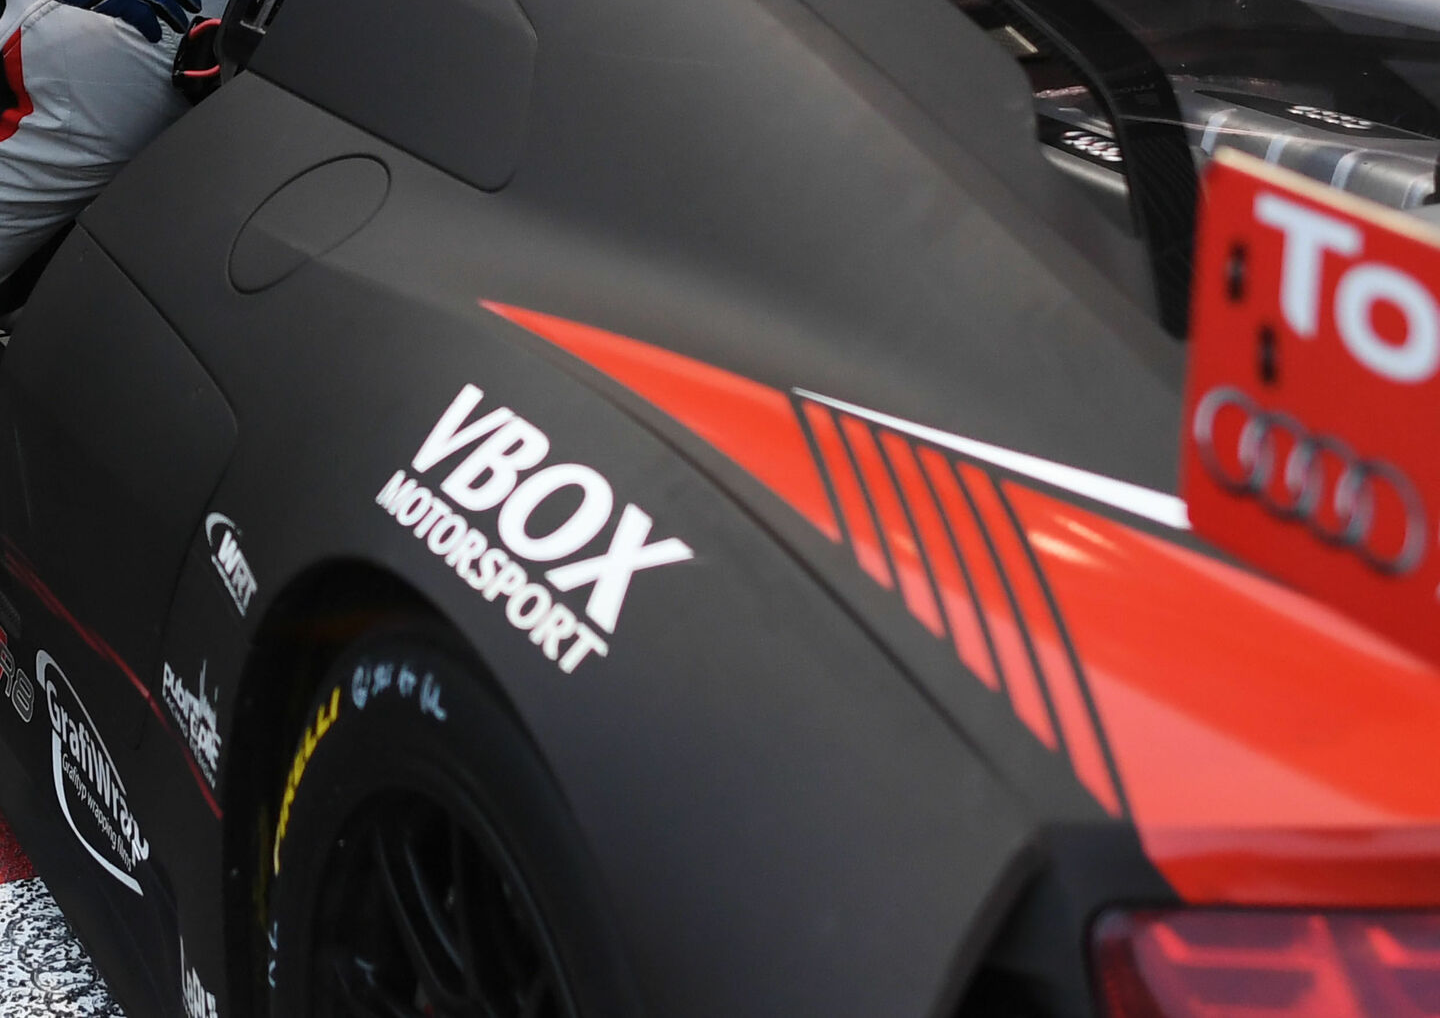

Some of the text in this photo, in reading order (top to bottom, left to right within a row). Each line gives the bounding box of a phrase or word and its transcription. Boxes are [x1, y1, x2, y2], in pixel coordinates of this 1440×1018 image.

[217, 529, 258, 609] WRT
[374, 470, 609, 675] MOTORSPORT
[411, 383, 694, 634] VBOX
